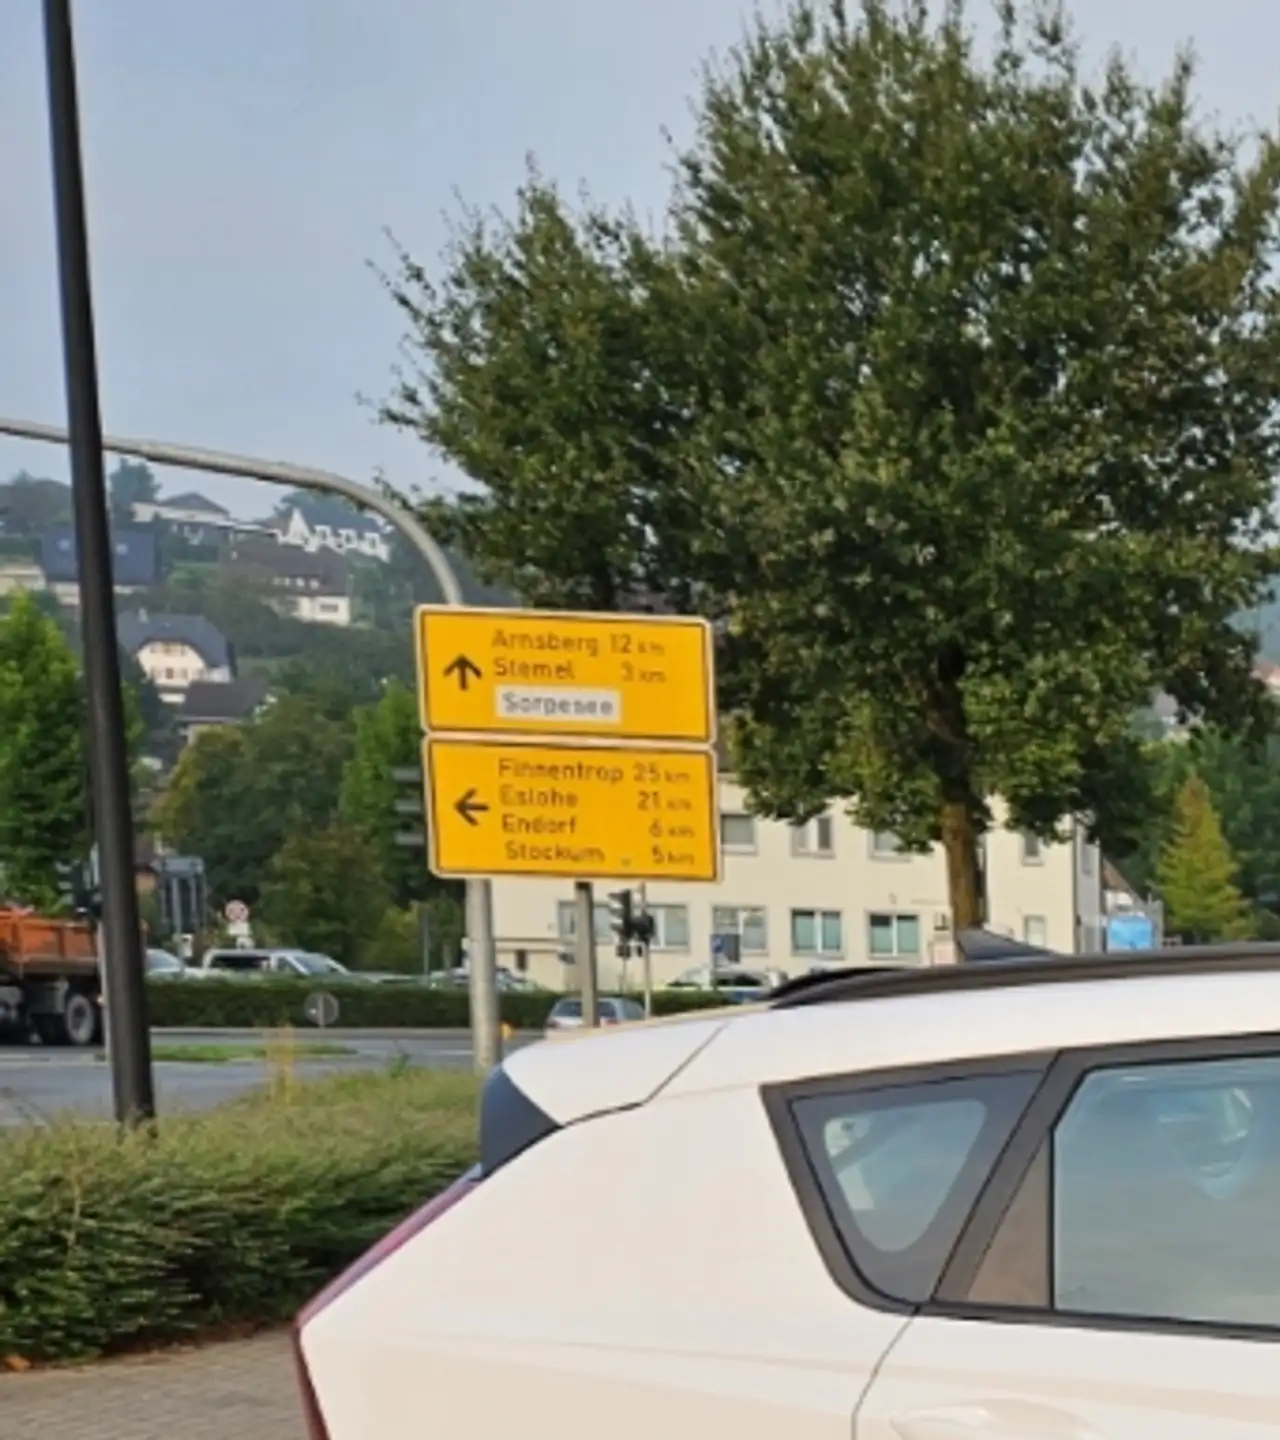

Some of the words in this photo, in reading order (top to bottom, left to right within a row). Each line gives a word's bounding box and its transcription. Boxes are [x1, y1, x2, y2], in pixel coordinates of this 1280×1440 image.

[492, 629, 599, 657] Arnsberg
[610, 633, 632, 654] 12
[637, 640, 666, 655] km
[493, 657, 575, 680] Stemel
[638, 668, 667, 684] km
[502, 691, 614, 716] Sorpesee
[498, 757, 624, 786] Finnentrop
[633, 761, 661, 782] 25
[665, 769, 692, 783] km
[500, 783, 579, 808] Eslohe
[637, 789, 660, 811] 21
[502, 812, 577, 835] Endorf
[504, 839, 606, 864] Stockum
